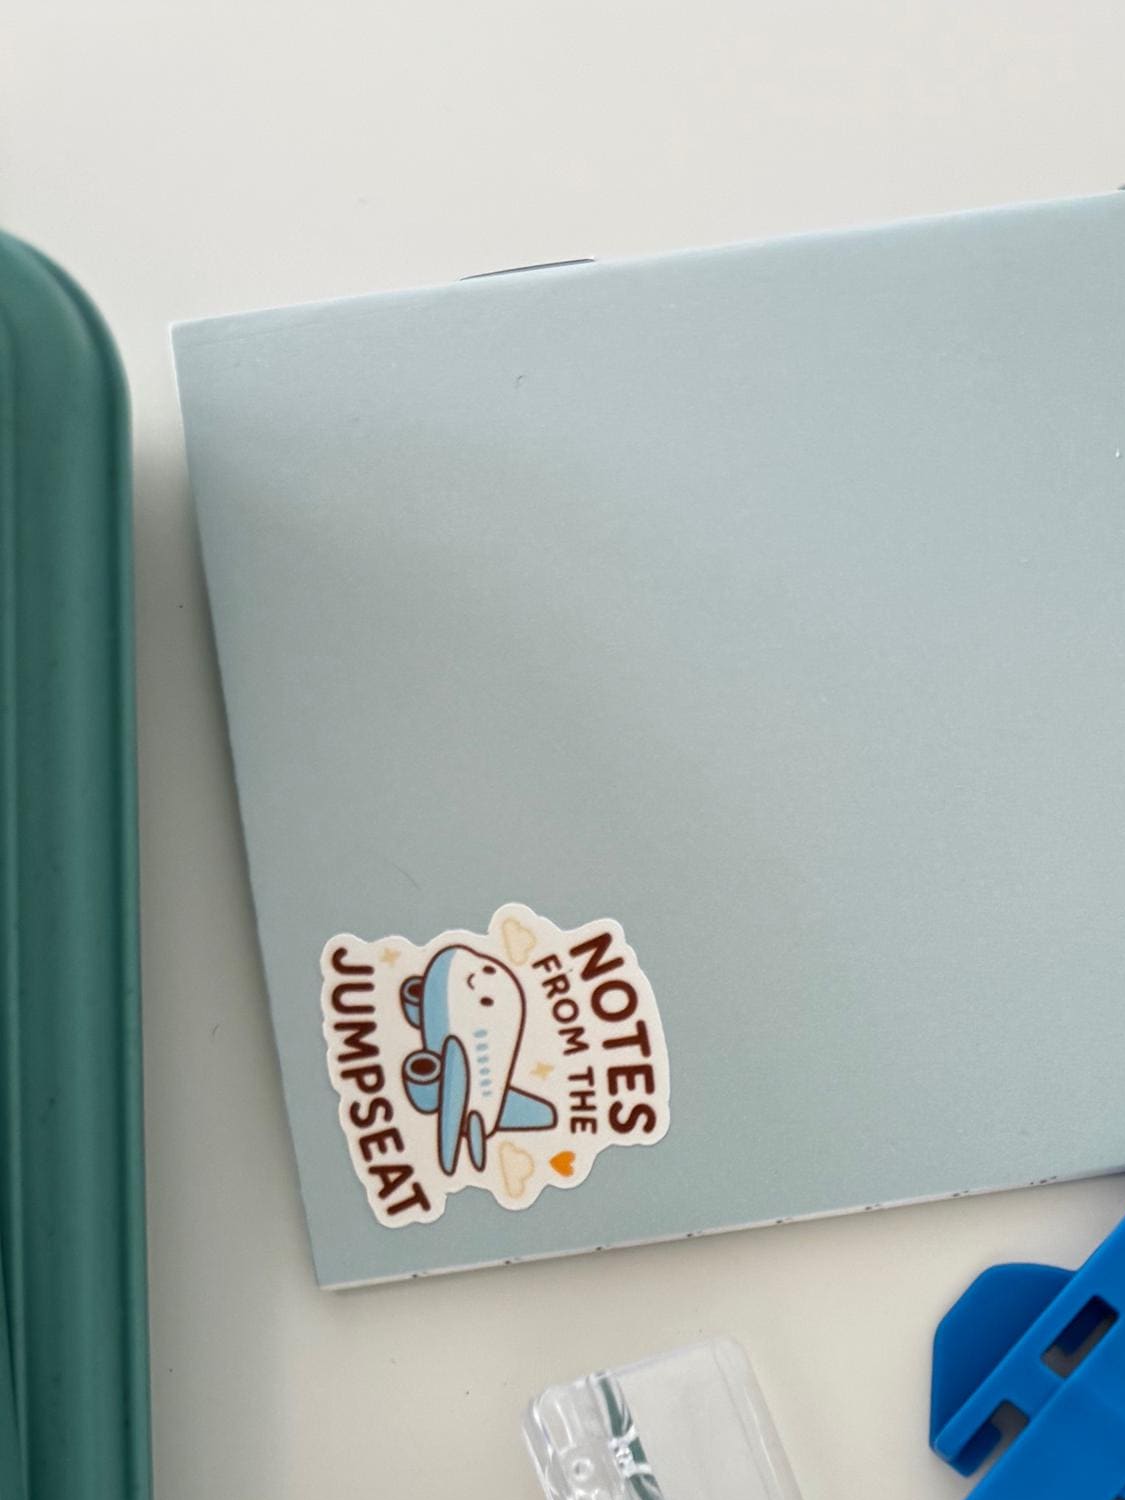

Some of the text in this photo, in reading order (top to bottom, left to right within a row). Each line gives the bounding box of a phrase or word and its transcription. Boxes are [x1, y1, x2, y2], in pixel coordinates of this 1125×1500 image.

[331, 947, 431, 1216] JUMPSEAT
[532, 954, 598, 1135] FROM THE
[570, 932, 656, 1134] NOTES
